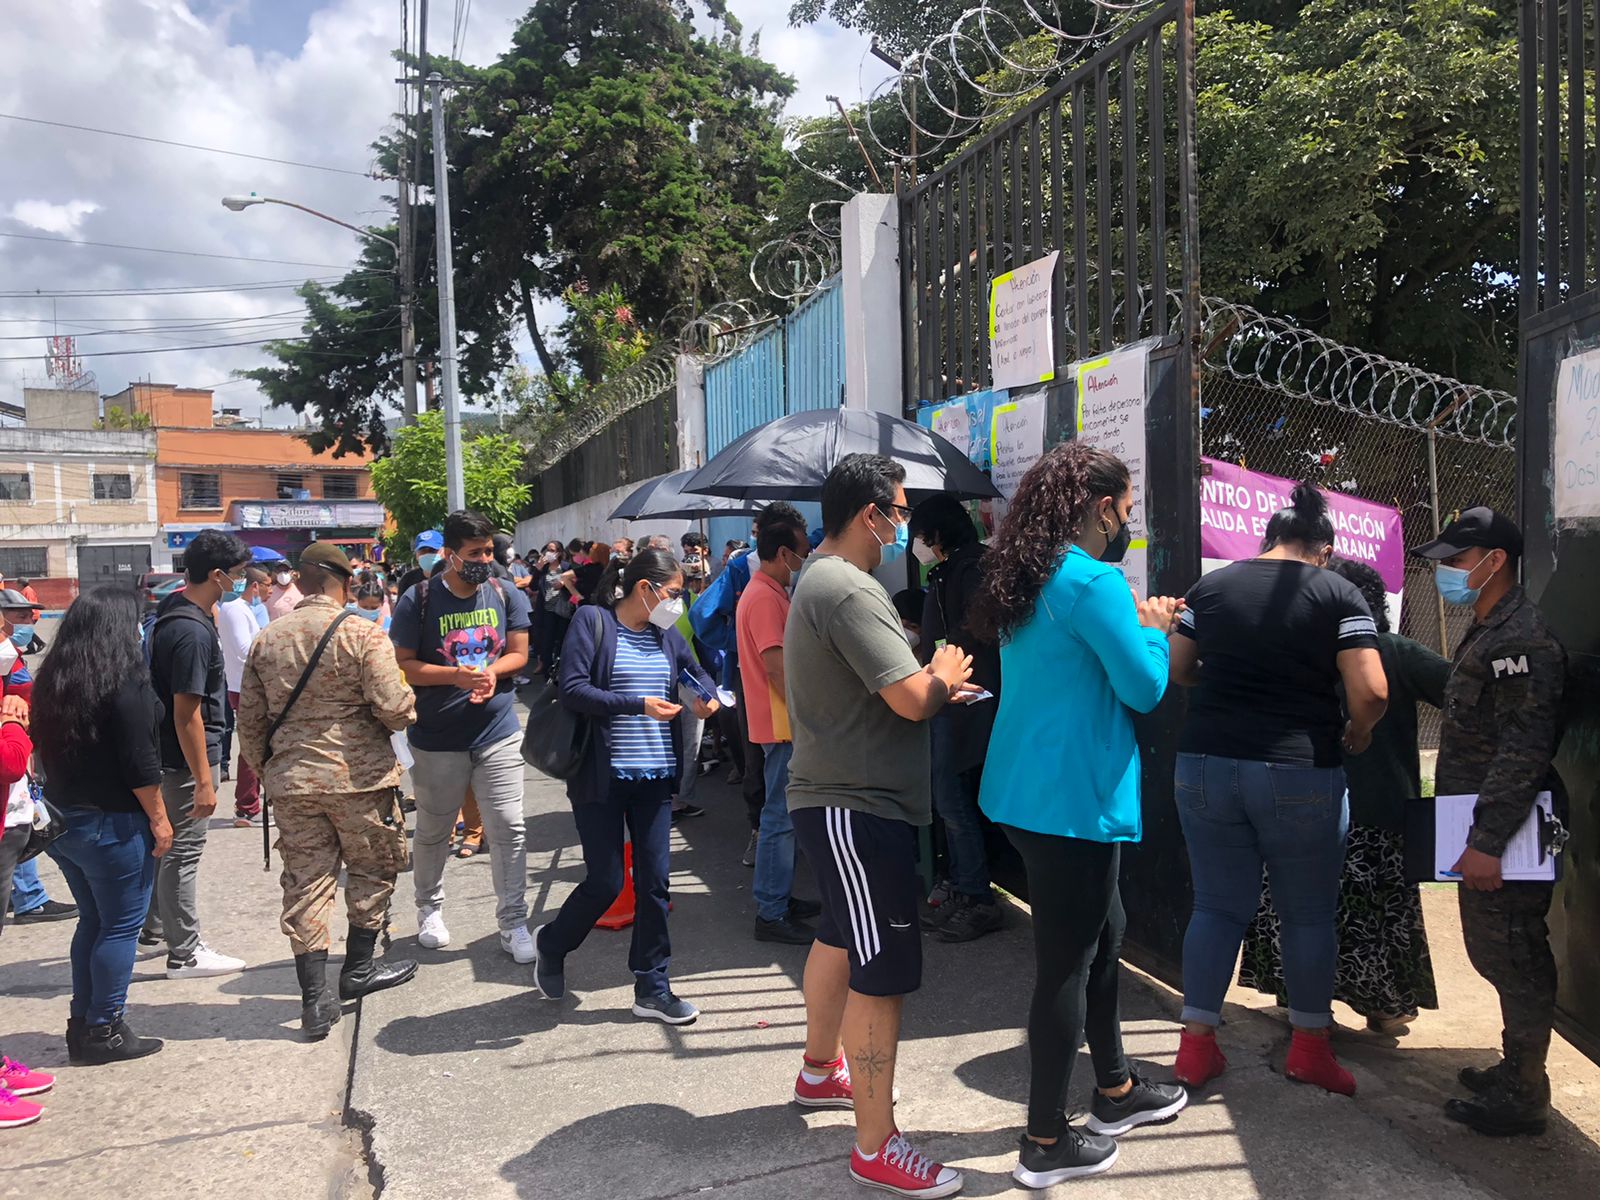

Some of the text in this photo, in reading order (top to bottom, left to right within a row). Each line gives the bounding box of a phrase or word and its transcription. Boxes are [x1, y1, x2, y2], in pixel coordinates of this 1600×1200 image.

[1087, 373, 1118, 393] Atención
[1200, 478, 1251, 511] NTRO
[1256, 489, 1279, 514] DE
[1201, 506, 1249, 535] ALIDA
[439, 607, 499, 637] HYPNOTIZED
[1491, 655, 1529, 679] PM
